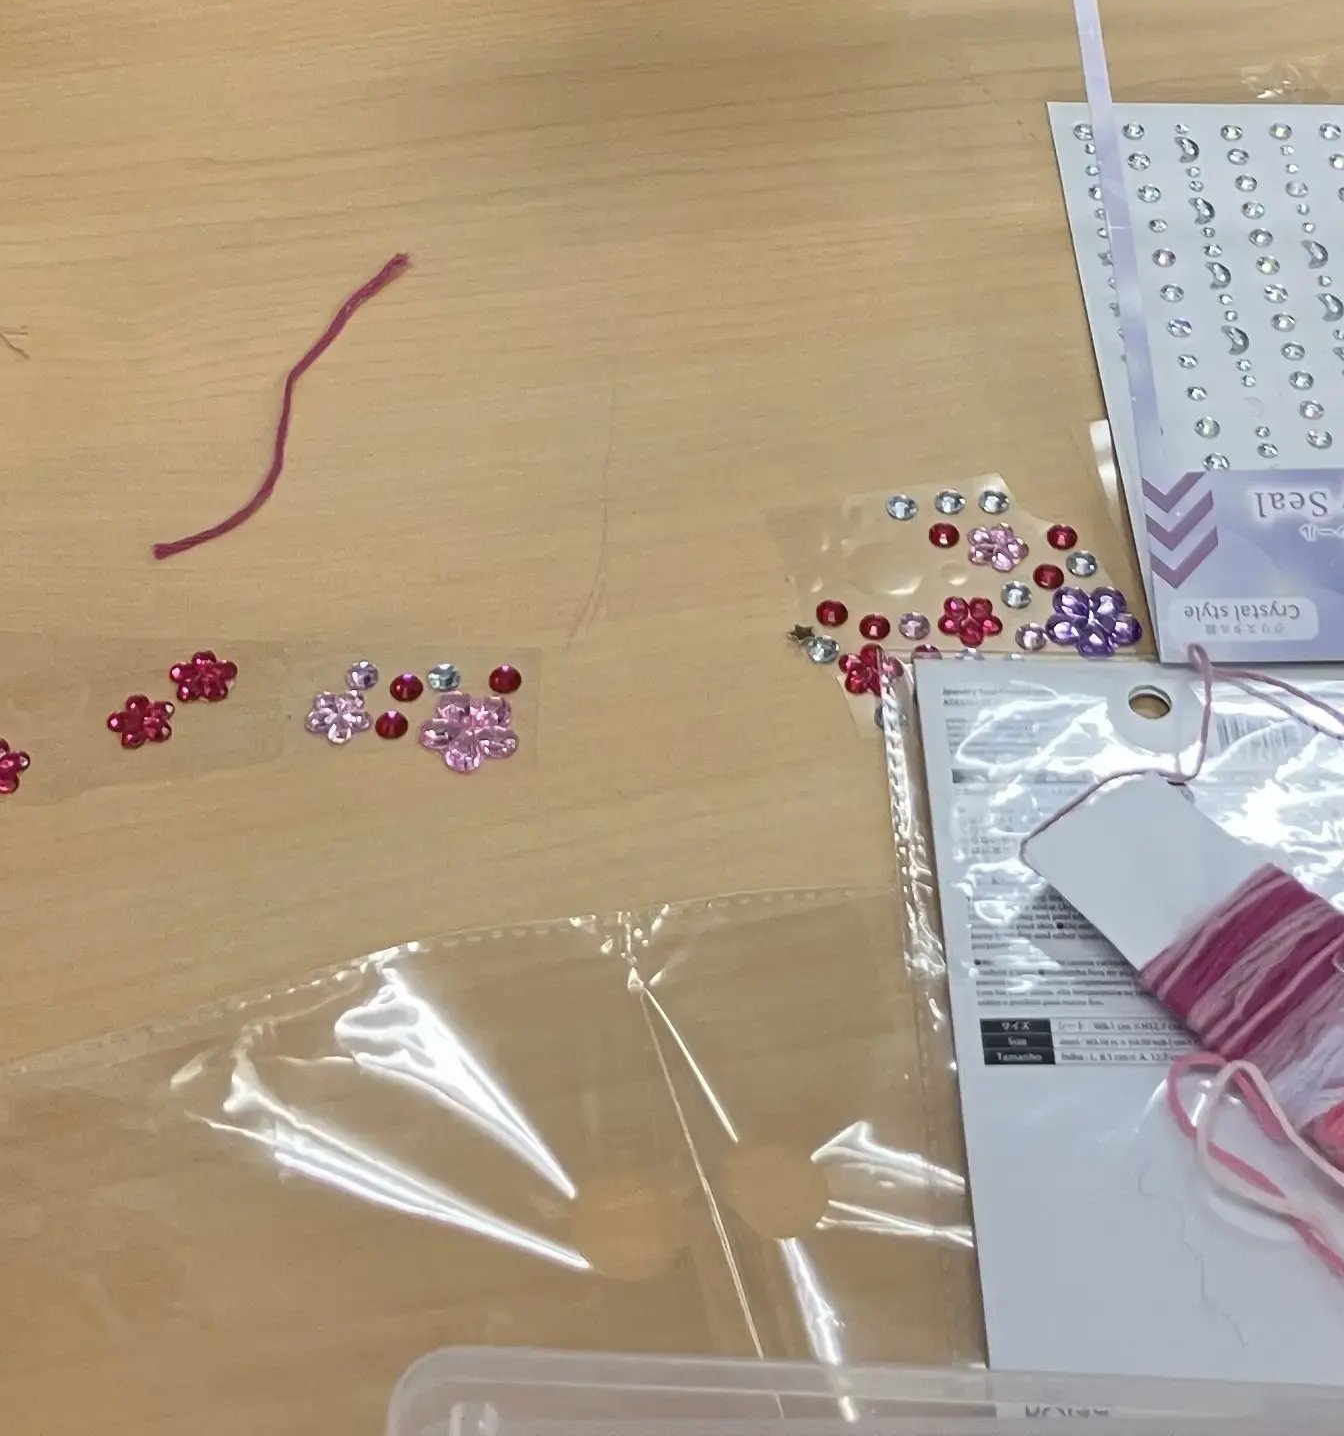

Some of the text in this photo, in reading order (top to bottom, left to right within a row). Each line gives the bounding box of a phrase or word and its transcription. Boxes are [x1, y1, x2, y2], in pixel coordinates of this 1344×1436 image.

[1254, 490, 1328, 519] Seal
[1184, 603, 1301, 621] Crystal style
[996, 1052, 1043, 1062] Tamanho
